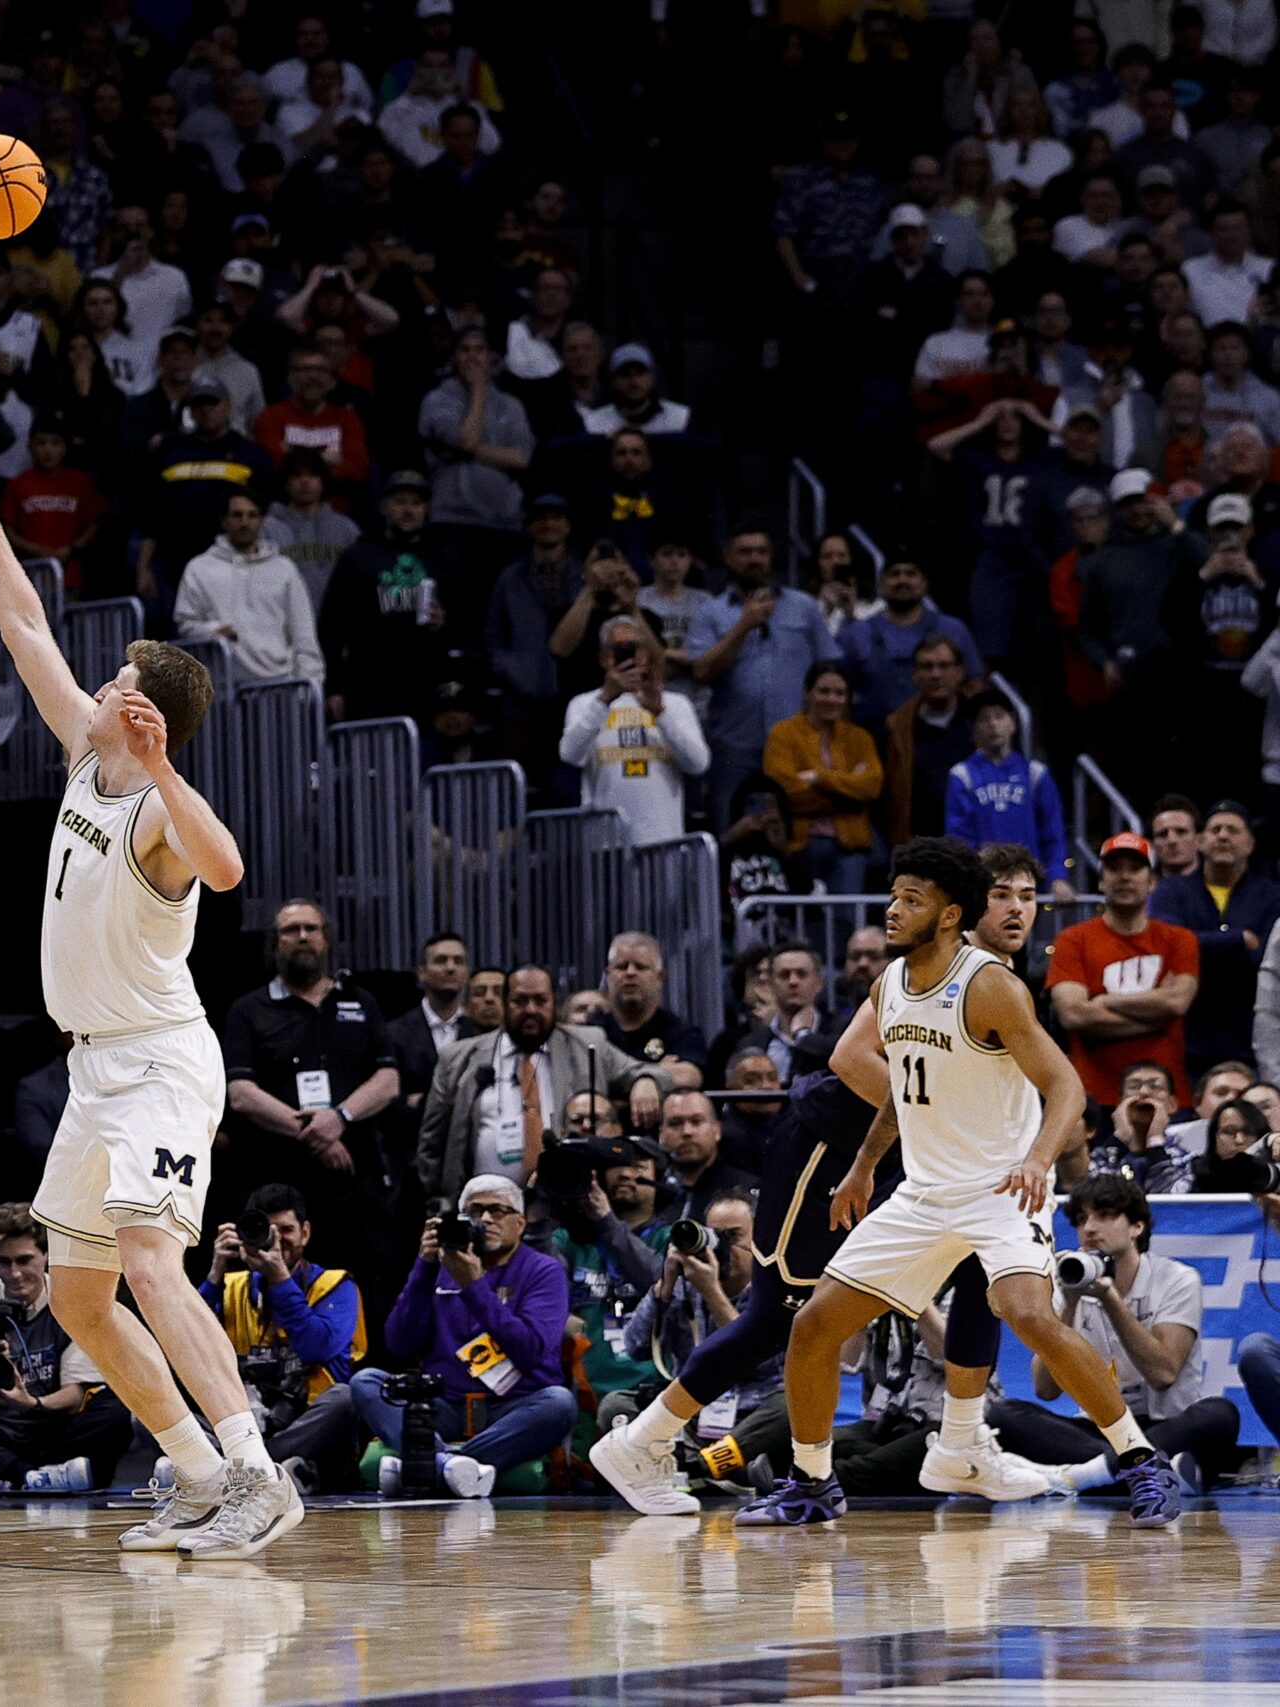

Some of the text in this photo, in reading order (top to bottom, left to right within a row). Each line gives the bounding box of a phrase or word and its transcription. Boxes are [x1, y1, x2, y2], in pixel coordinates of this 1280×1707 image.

[54, 847, 73, 901] 1
[883, 1023, 953, 1053] MICHIGAN
[902, 1054, 930, 1105] 11
[152, 1146, 197, 1188] M
